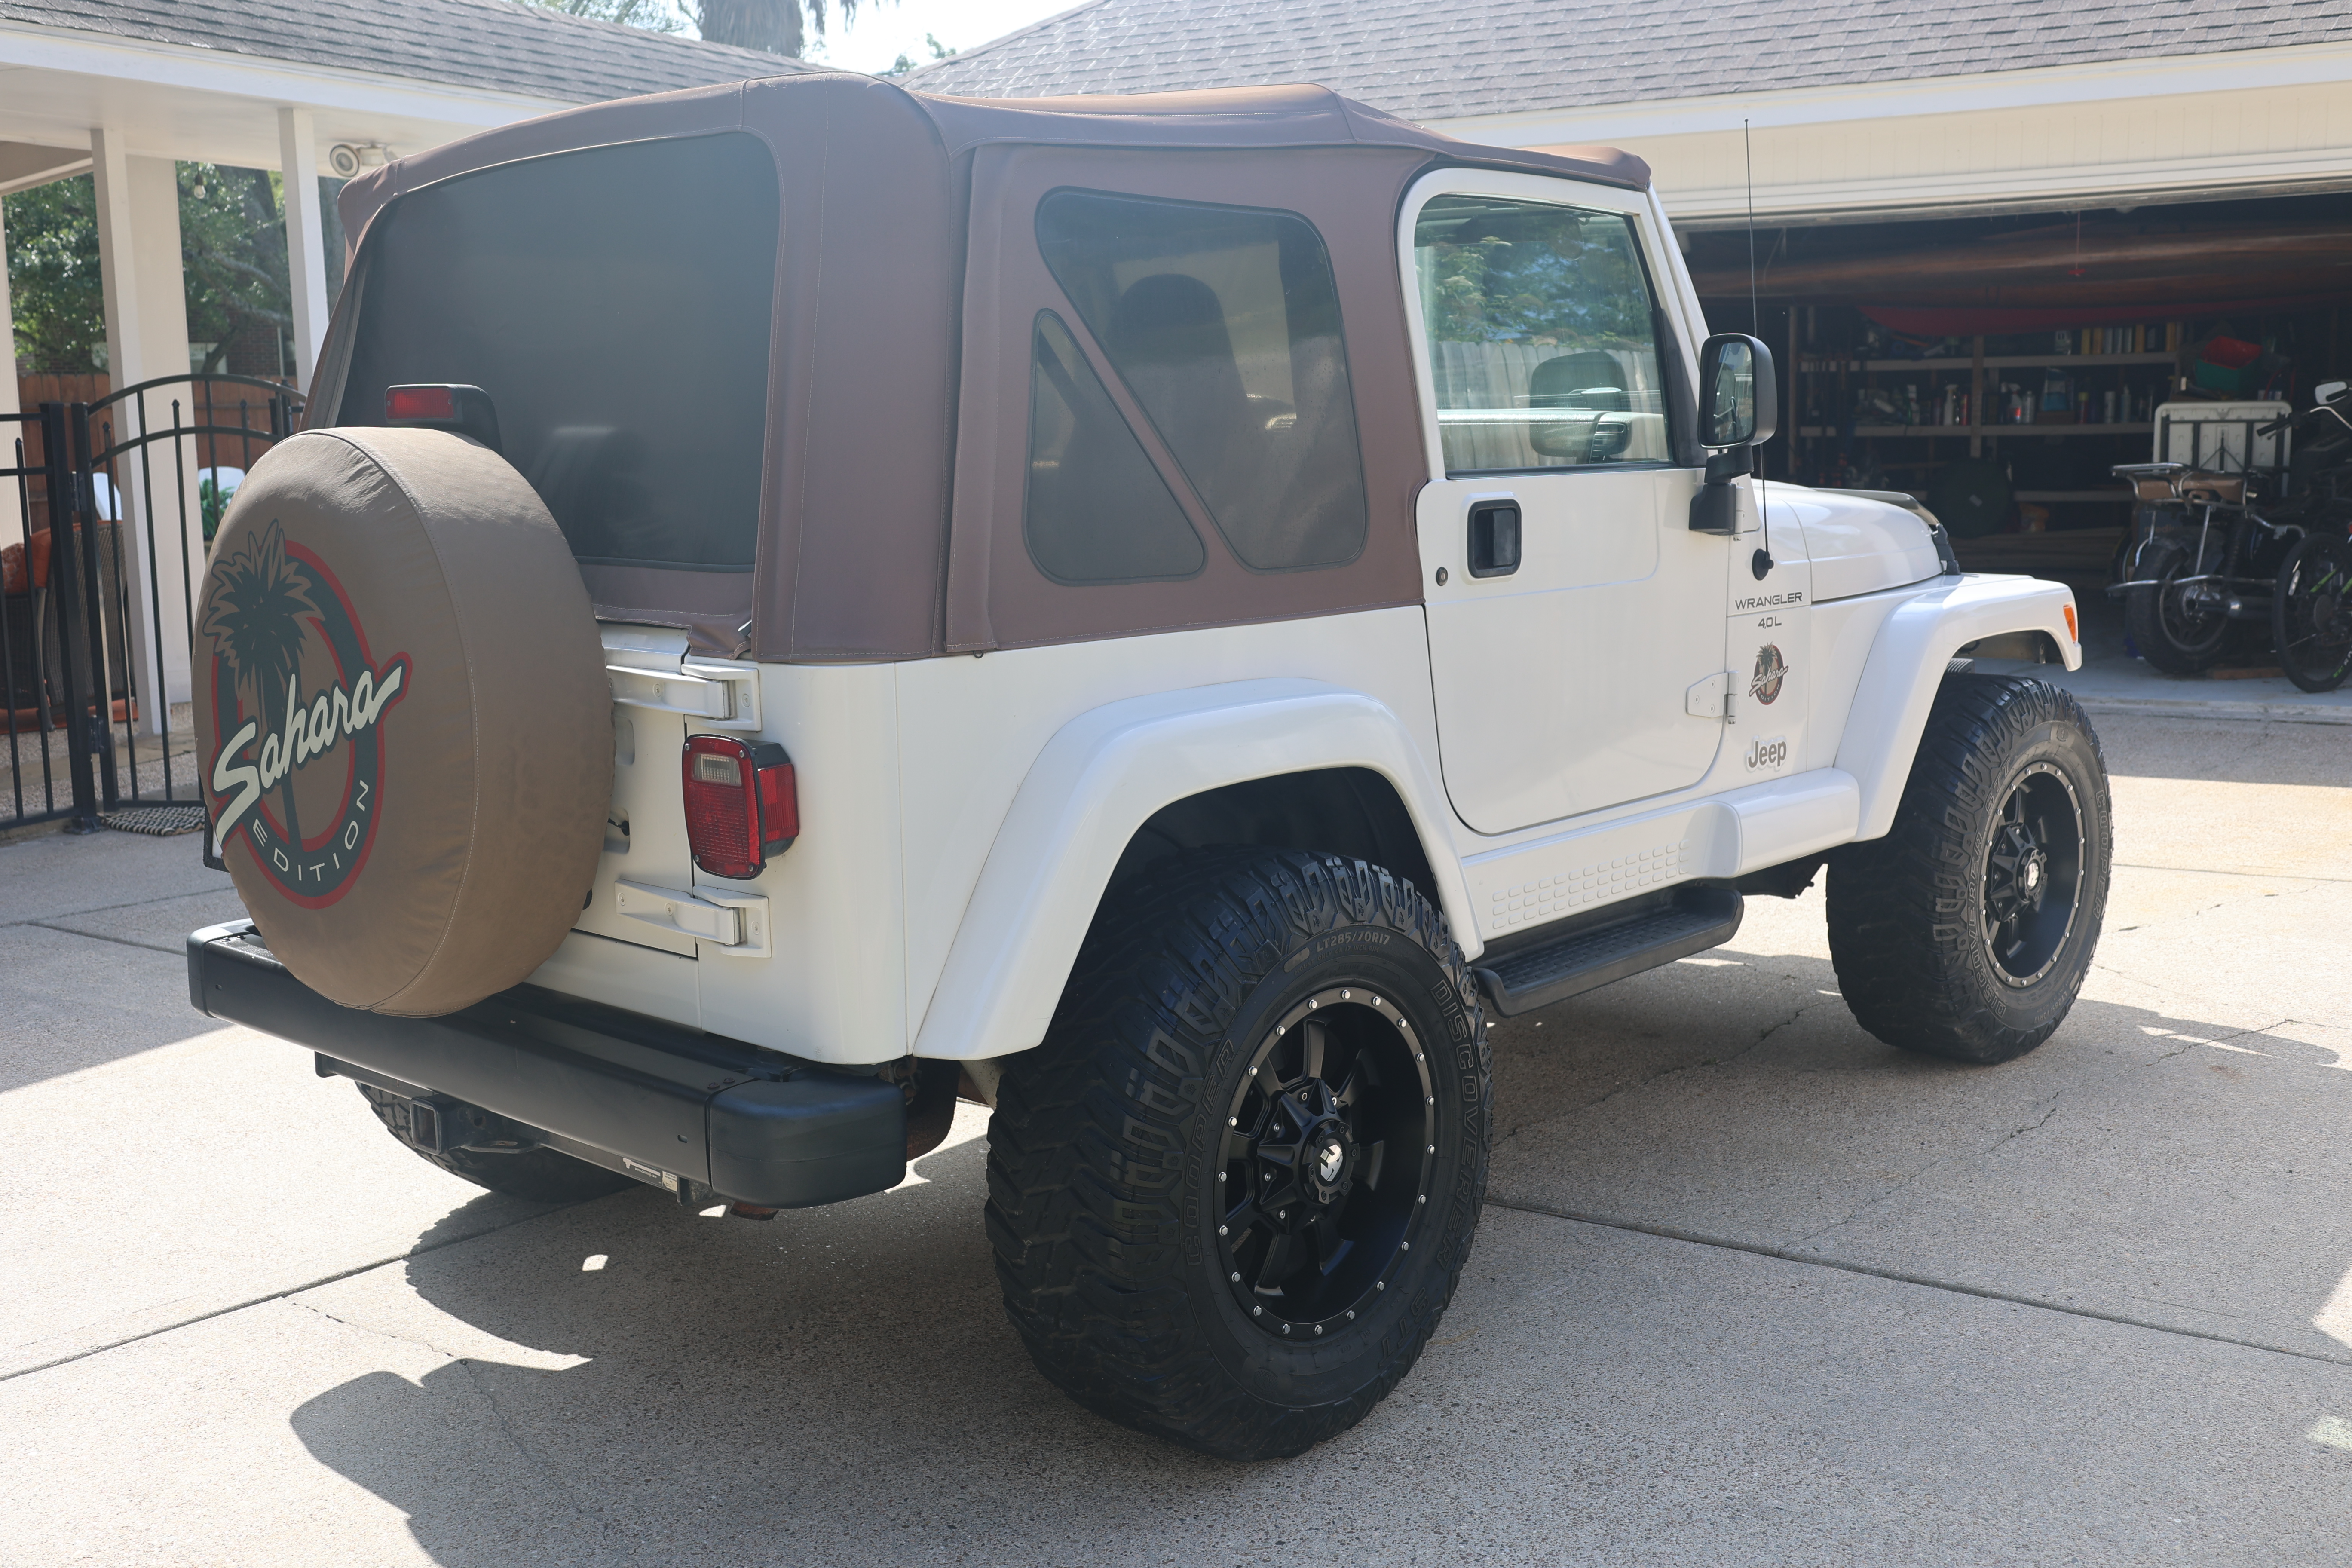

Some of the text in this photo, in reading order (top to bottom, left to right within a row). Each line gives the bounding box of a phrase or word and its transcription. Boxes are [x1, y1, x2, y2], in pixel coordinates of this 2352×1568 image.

[1735, 592, 1803, 610] WRANGLER
[1749, 667, 1788, 696] Sahara
[1758, 684, 1780, 701] EDITION
[214, 666, 402, 845] Sahara
[1748, 740, 1787, 768] Jeep
[1985, 756, 2011, 814] STT
[253, 779, 369, 882] EDITION
[2093, 789, 2109, 921] COOPER
[1316, 931, 1390, 952] LT285/70R17
[1967, 832, 2006, 1018] DISCOVERER
[1295, 959, 1315, 975] MOUNT
[1318, 951, 1332, 961] ONLY
[1184, 1038, 1234, 1266] COOPER
[1430, 983, 1479, 1271] DISCOVERER
[1378, 1286, 1429, 1369] STT
